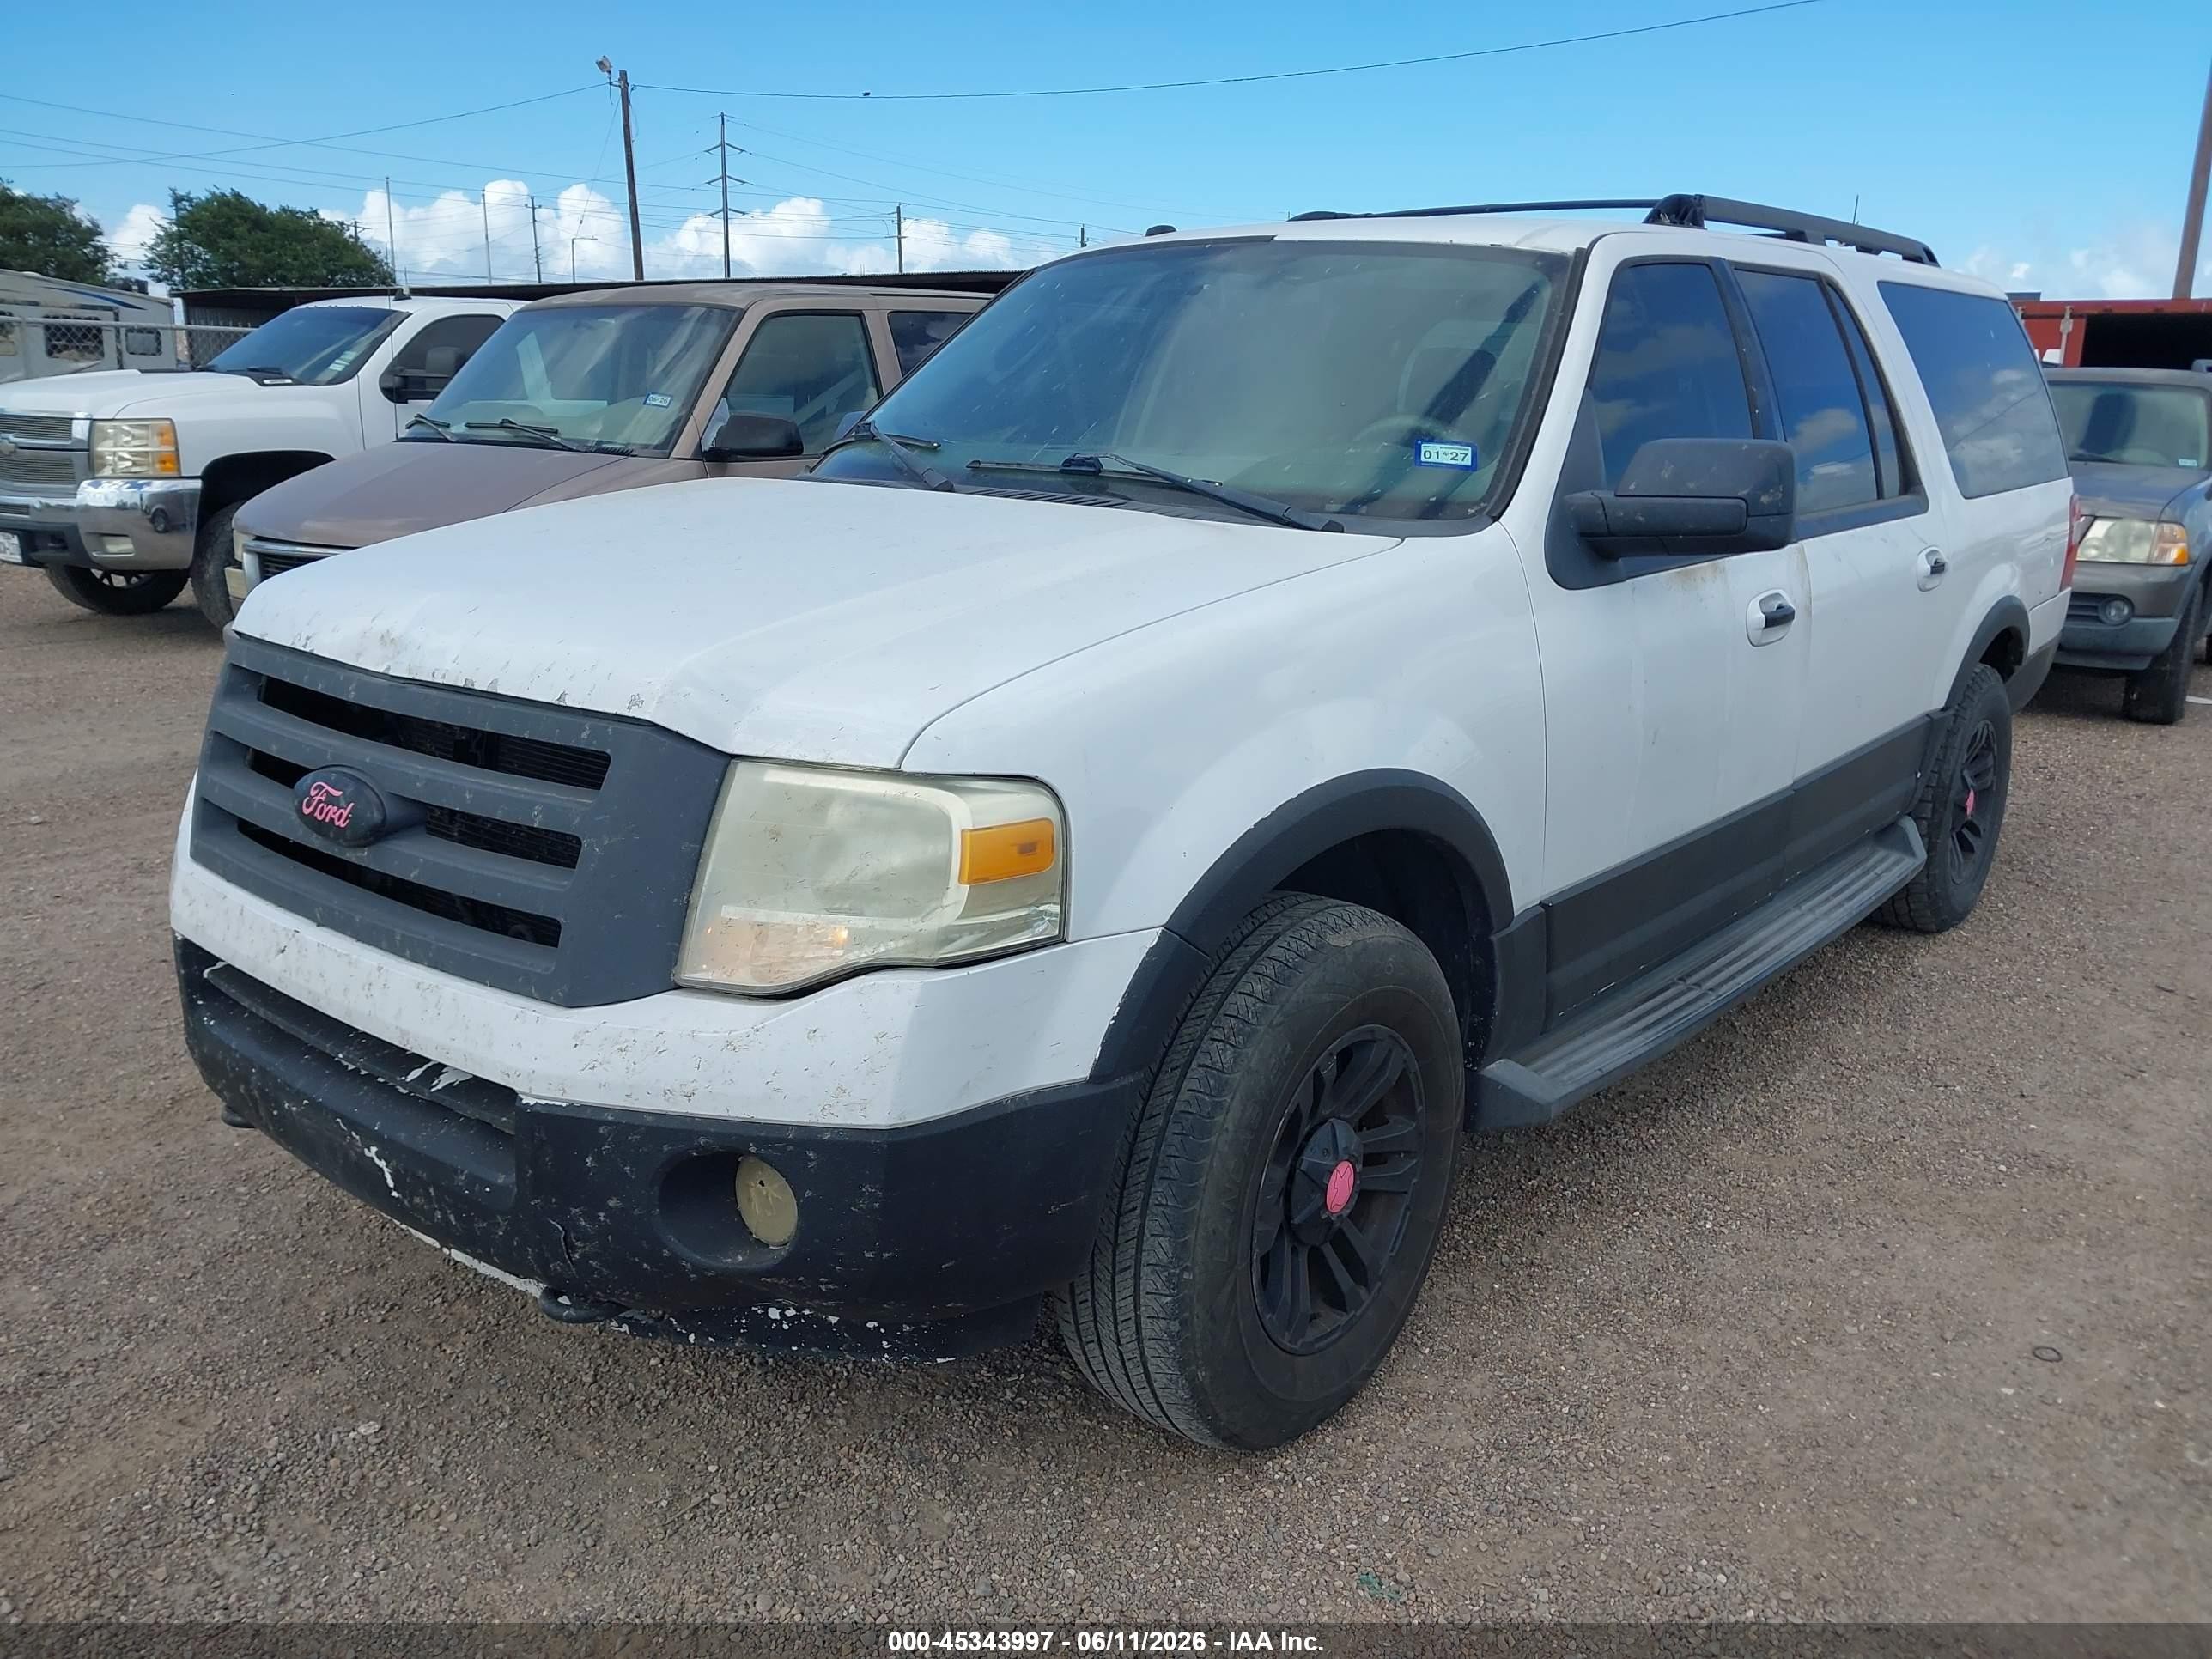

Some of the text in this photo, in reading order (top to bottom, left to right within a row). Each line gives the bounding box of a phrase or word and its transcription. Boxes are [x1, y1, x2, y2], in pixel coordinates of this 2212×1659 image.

[1423, 450, 1469, 462] 01 27
[302, 781, 355, 828] Ford
